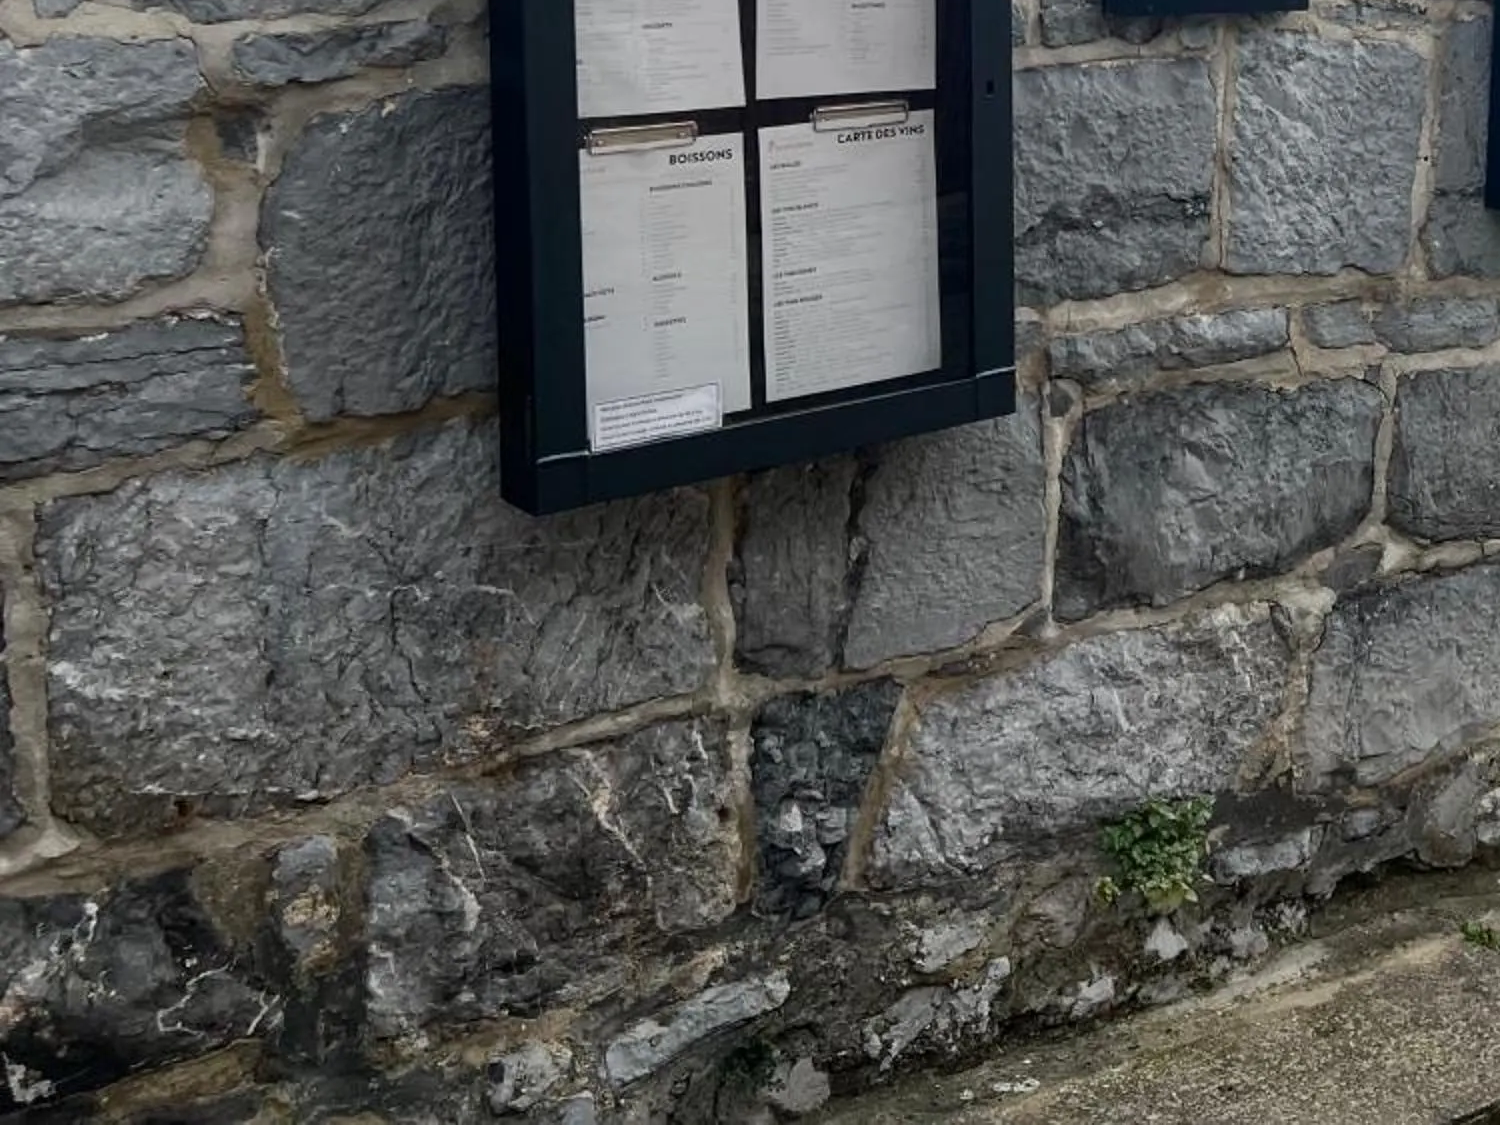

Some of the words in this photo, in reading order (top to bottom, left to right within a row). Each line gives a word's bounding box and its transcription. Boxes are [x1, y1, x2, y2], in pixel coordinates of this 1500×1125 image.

[837, 132, 874, 144] CARTE
[876, 128, 897, 140] DES
[900, 125, 925, 136] VINS
[669, 149, 733, 165] BOISSONS
